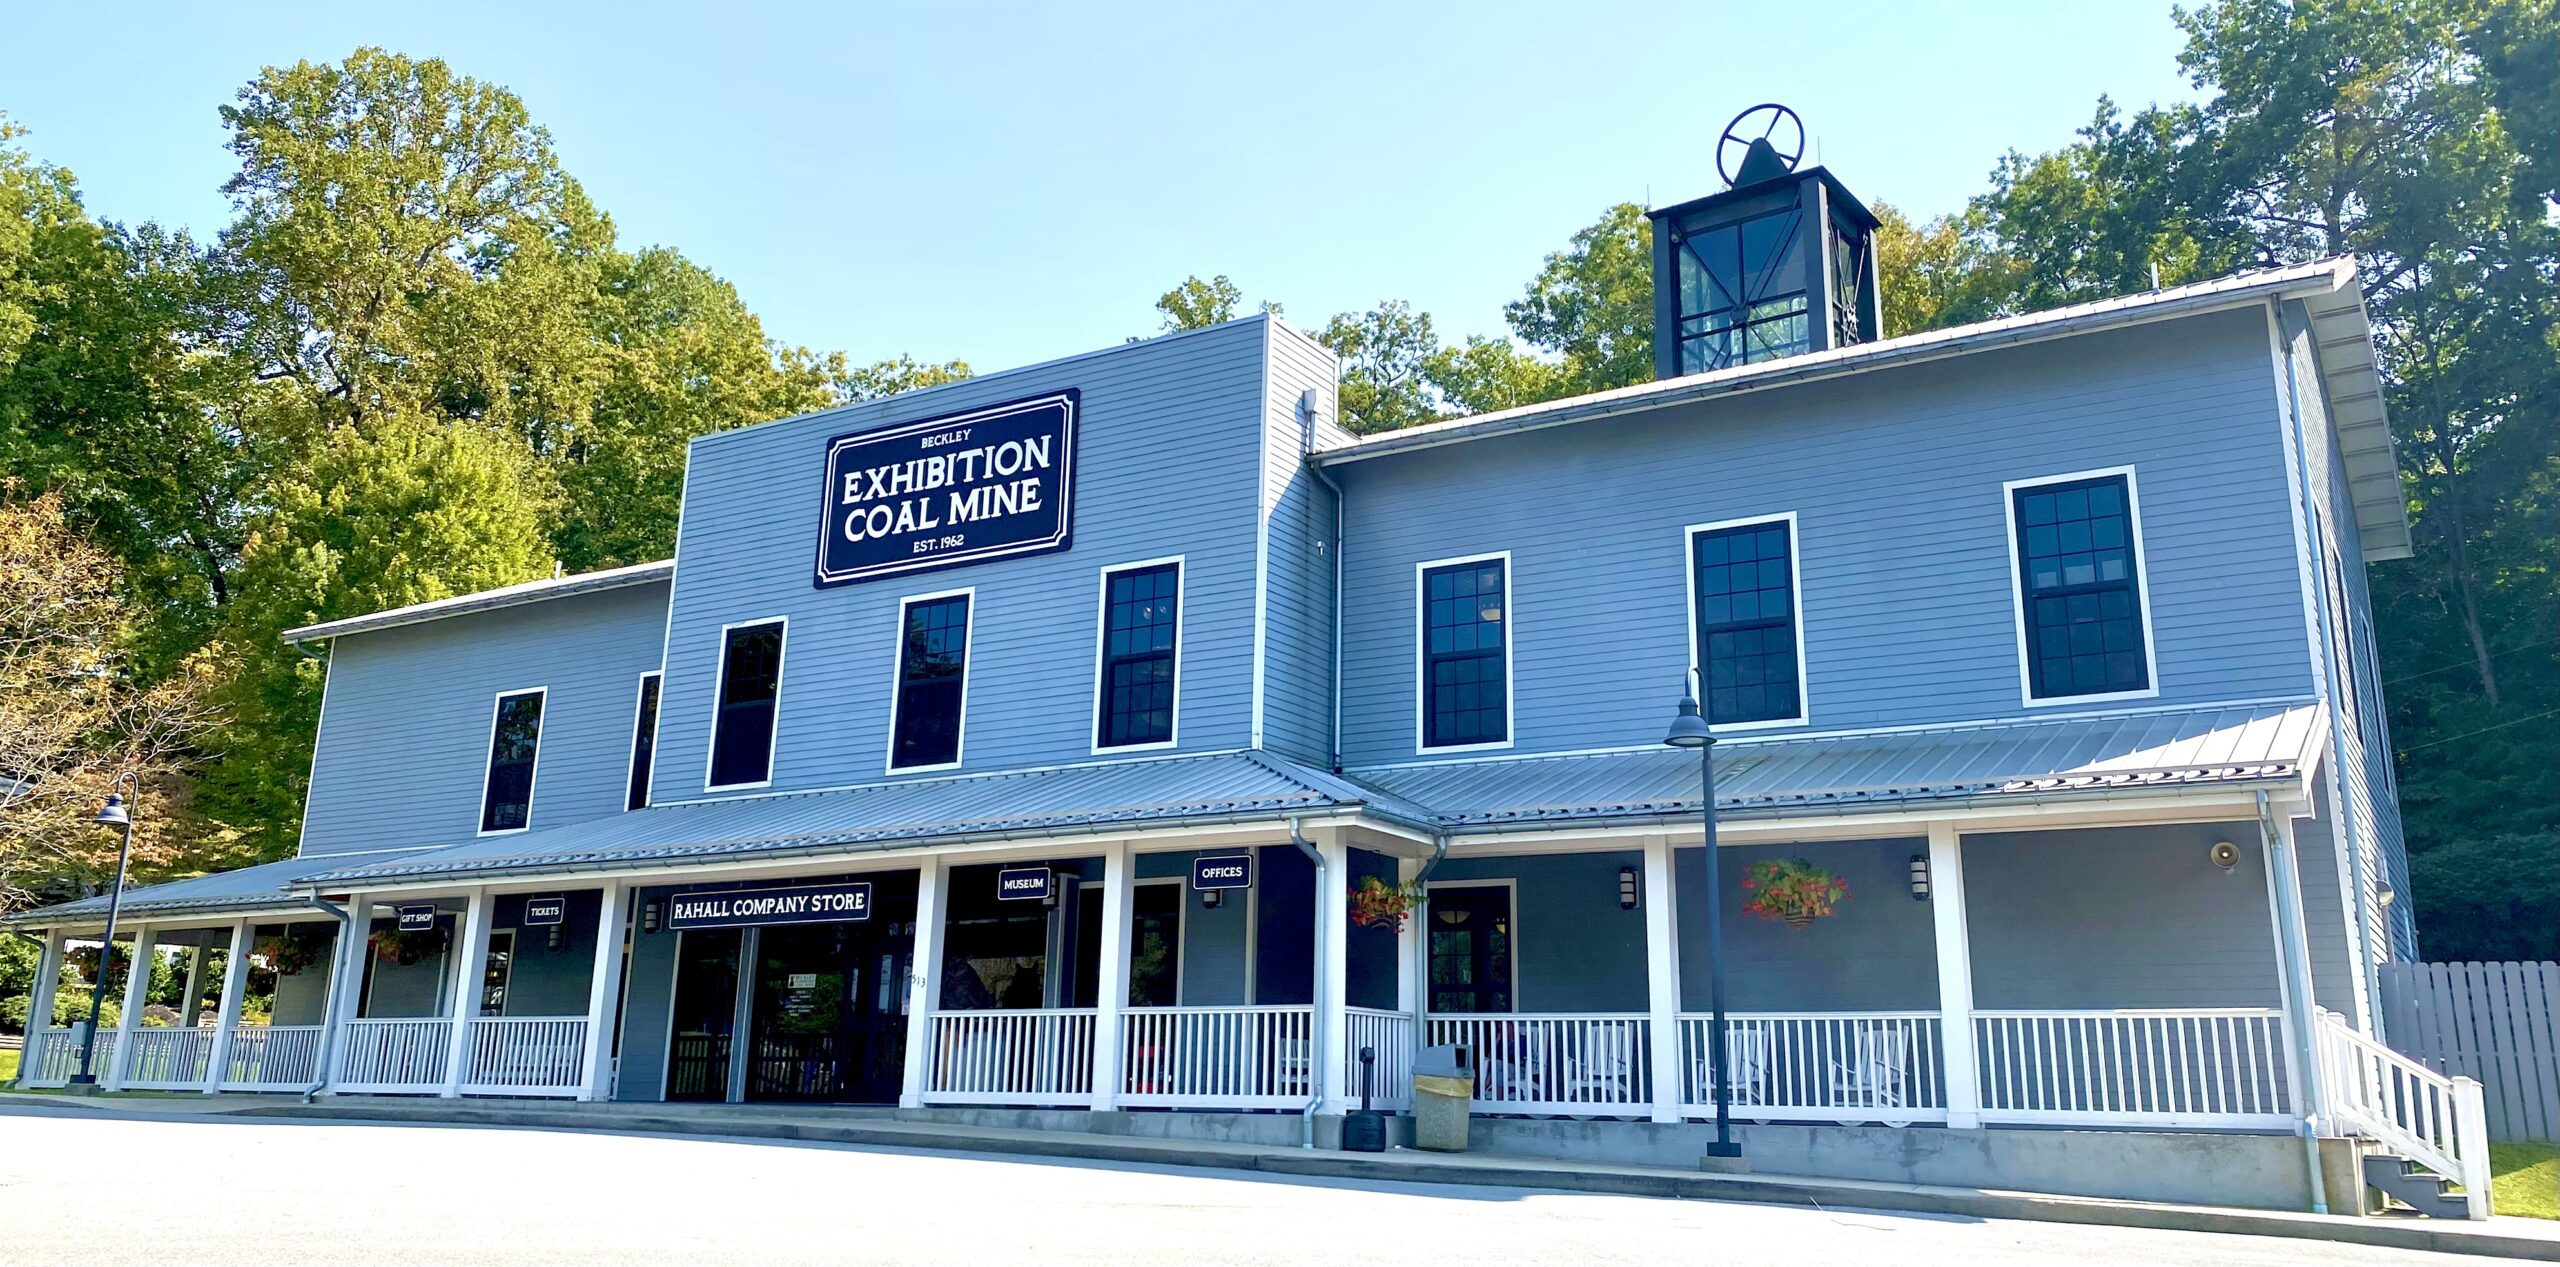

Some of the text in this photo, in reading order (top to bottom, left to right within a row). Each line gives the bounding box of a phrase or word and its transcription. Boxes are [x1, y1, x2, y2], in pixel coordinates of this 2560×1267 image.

[921, 428, 972, 449] BECKLEY
[841, 434, 1052, 505] EXHIBITION
[844, 477, 1043, 542] COAL MINE
[913, 533, 965, 554] EST. 1962
[1202, 866, 1243, 878] OFFICES
[1004, 878, 1044, 890] MUSEUM
[531, 907, 559, 917] TICKETS
[673, 892, 865, 919] RAHALL COMPANY STORE
[402, 913, 432, 923] GIFT SHOP
[911, 974, 926, 988] 513
